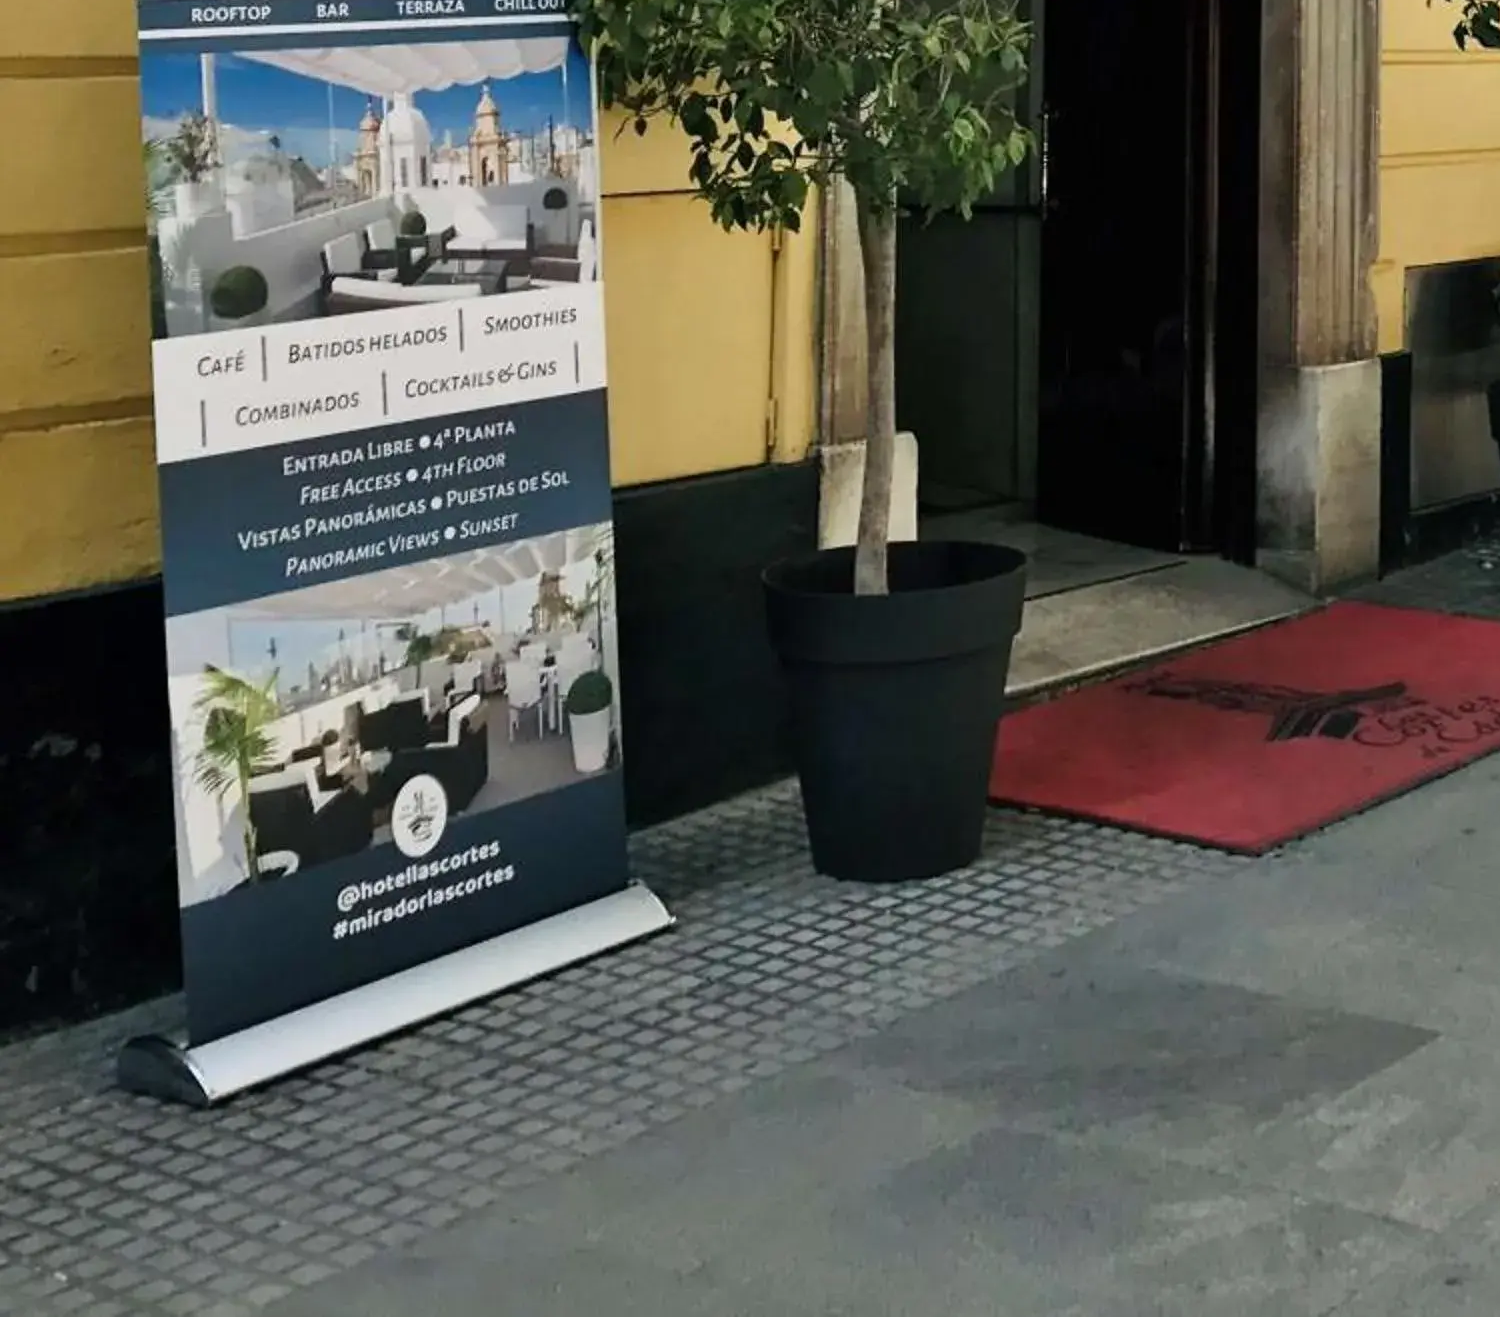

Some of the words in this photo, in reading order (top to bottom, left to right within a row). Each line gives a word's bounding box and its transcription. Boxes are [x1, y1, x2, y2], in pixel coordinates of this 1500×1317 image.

[191, 5, 272, 23] ROOFTOP
[316, 2, 350, 18] BAR
[288, 337, 365, 365] BATIDOS
[369, 326, 448, 352] HELADOS
[484, 308, 577, 335] SMOOTHIES
[405, 369, 495, 398] COCKTAILS
[497, 362, 515, 384] &
[517, 360, 558, 381] GINS
[235, 391, 360, 427] COMBINADOS
[283, 447, 365, 476] ENTRADA
[367, 438, 415, 461] LIBRE
[454, 420, 516, 444] PLANTA
[300, 483, 341, 506] FREE
[341, 471, 402, 498] ACCESS
[421, 461, 454, 483] 4TH
[456, 452, 507, 476] FLOOR
[237, 523, 300, 551] VISTAS
[304, 498, 427, 538] PANORÁMICAS
[446, 481, 515, 509] PUESTAS
[517, 476, 540, 495] DE
[540, 469, 571, 490] SOL
[284, 539, 387, 578] PANORAMIC
[388, 530, 440, 554] VIEWS
[459, 513, 520, 540] SUNSET
[332, 864, 516, 941] #miradorlascortes
[336, 839, 501, 913] @hotellascortes
